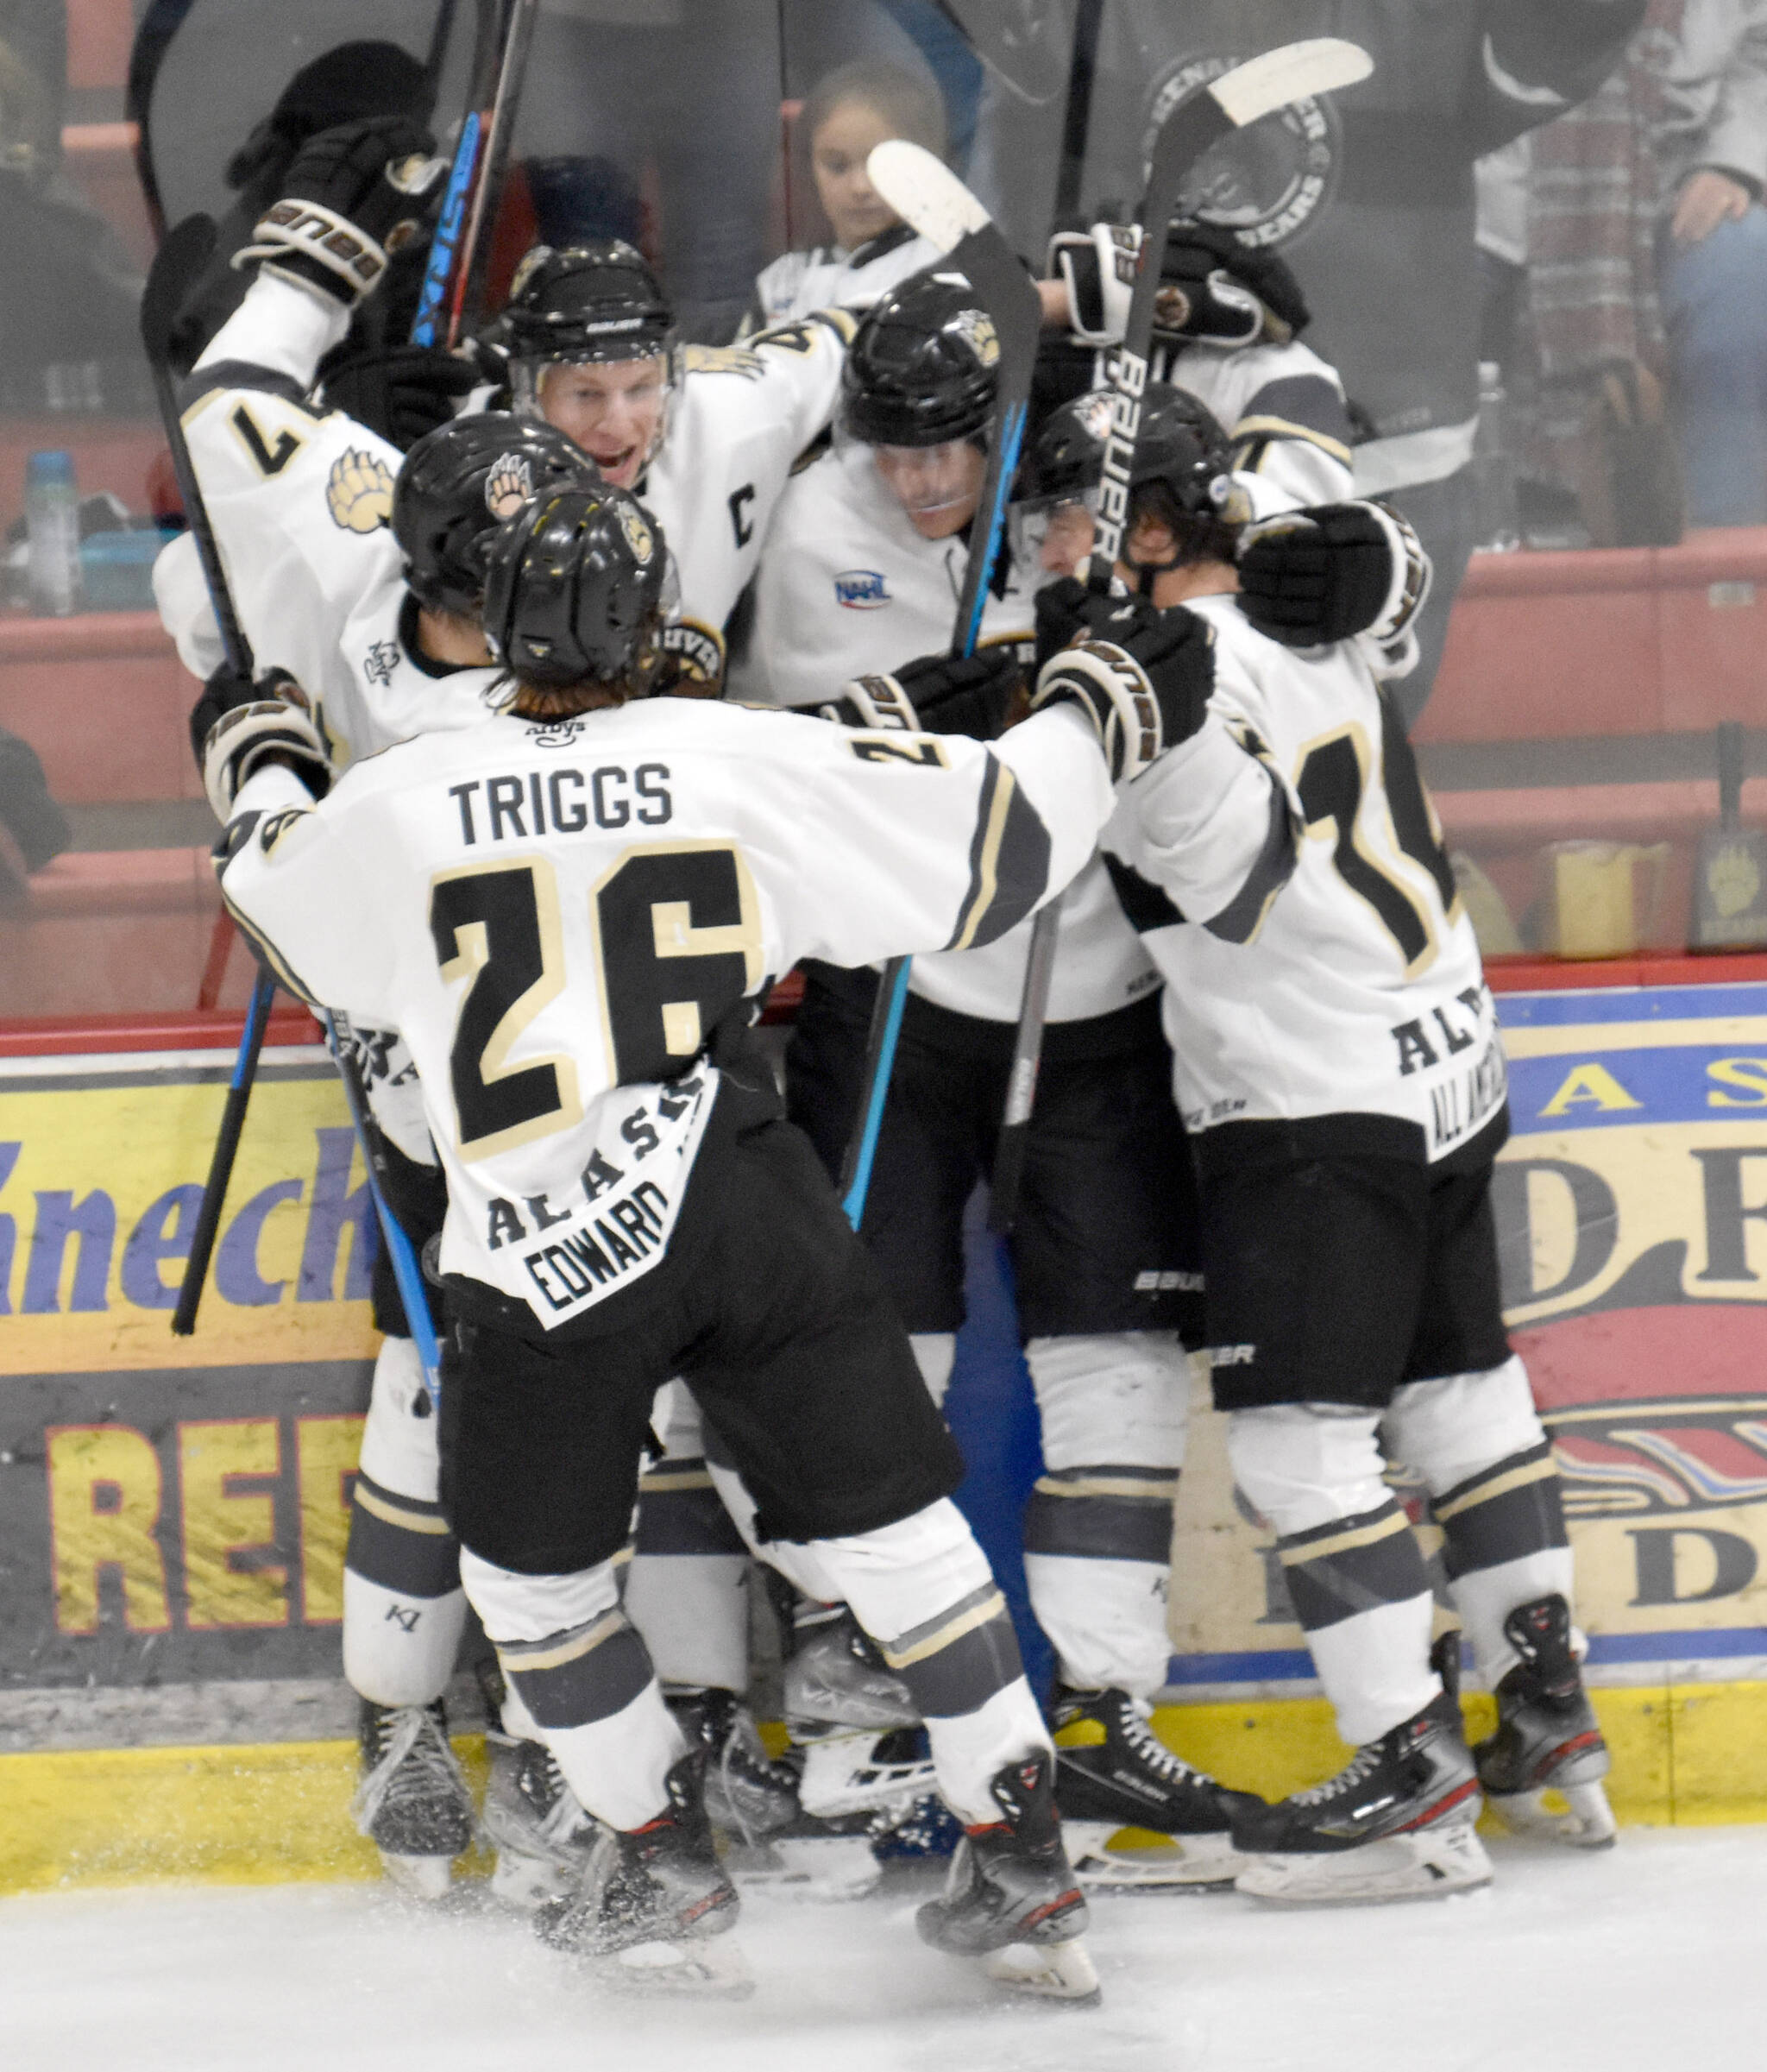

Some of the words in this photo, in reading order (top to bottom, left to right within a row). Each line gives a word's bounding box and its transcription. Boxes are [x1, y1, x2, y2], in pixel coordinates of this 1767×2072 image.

[728, 483, 756, 549] C
[1091, 348, 1148, 564] BAUER
[449, 763, 673, 845] TRIGGS
[428, 839, 764, 1163] 26
